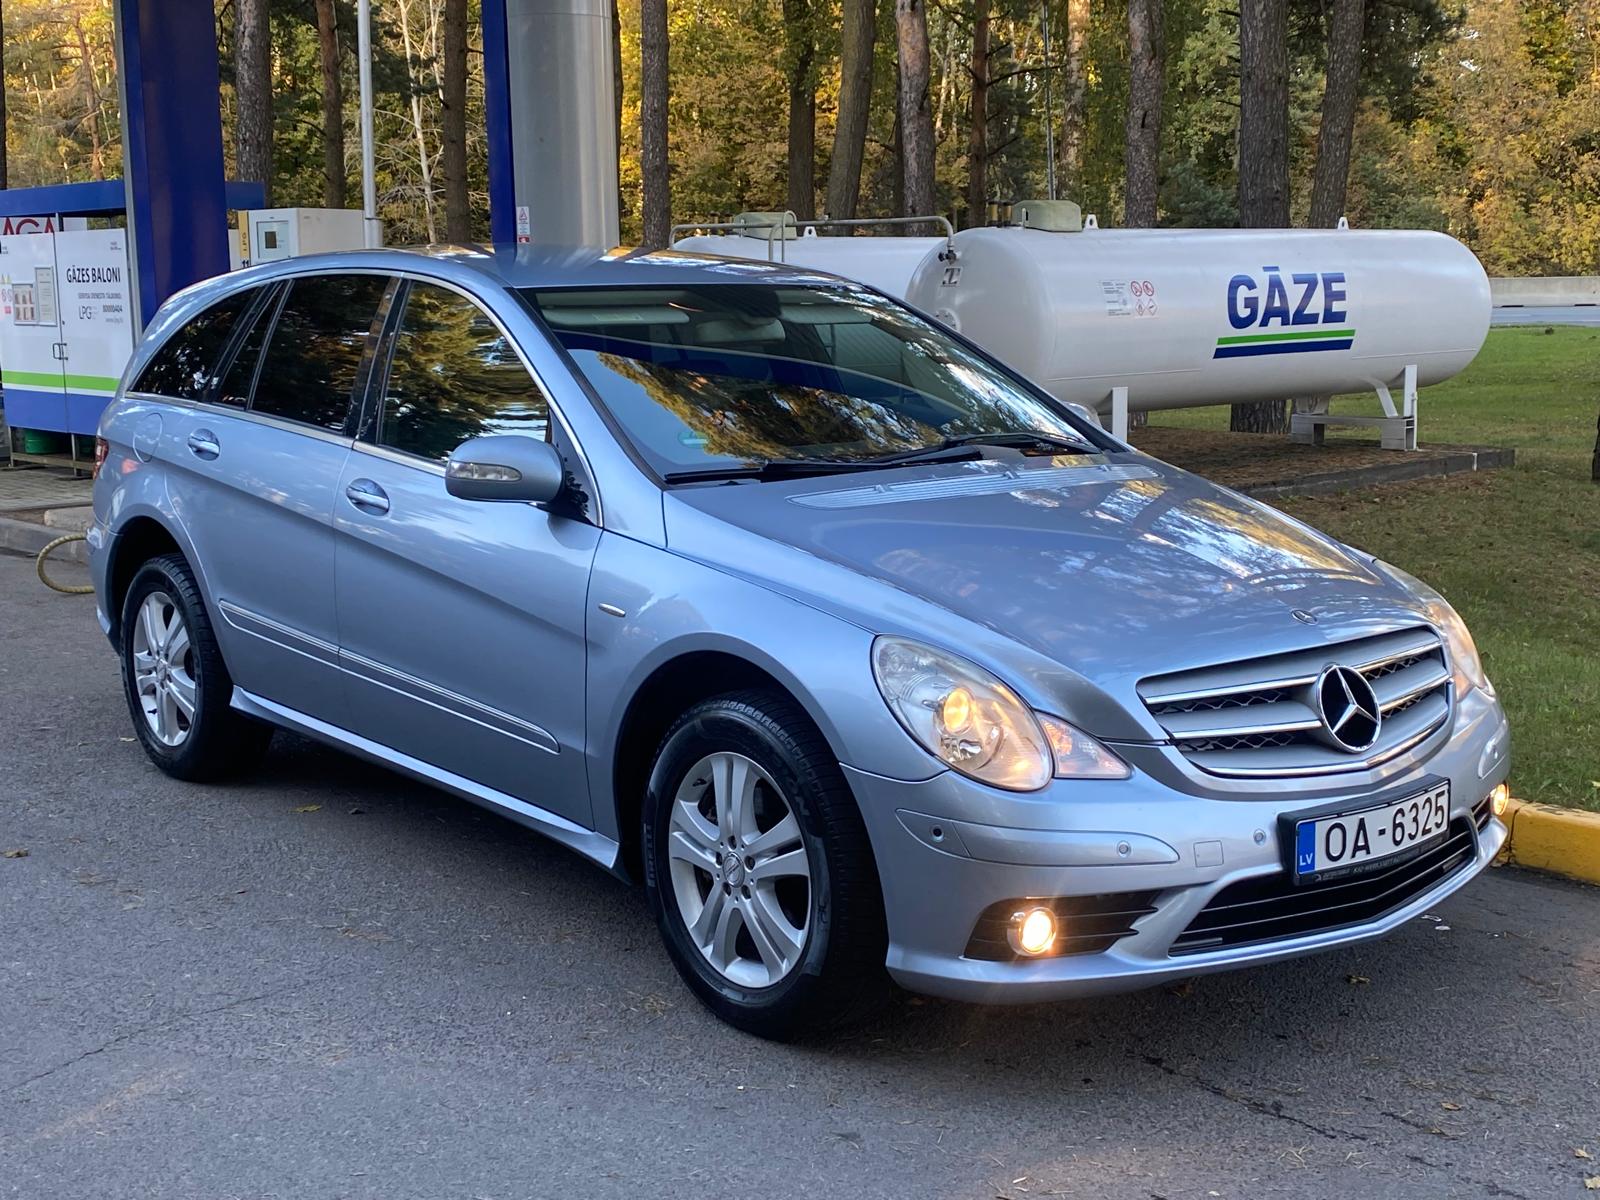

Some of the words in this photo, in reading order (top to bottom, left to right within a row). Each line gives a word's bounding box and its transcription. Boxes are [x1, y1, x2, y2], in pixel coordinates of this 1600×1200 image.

[66, 265, 90, 283] GĀZES
[91, 267, 121, 283] BALONI
[1227, 266, 1348, 330] GĀZE
[79, 305, 92, 320] LPG
[1325, 790, 1446, 862] OA-6325
[1300, 853, 1314, 866] LV
